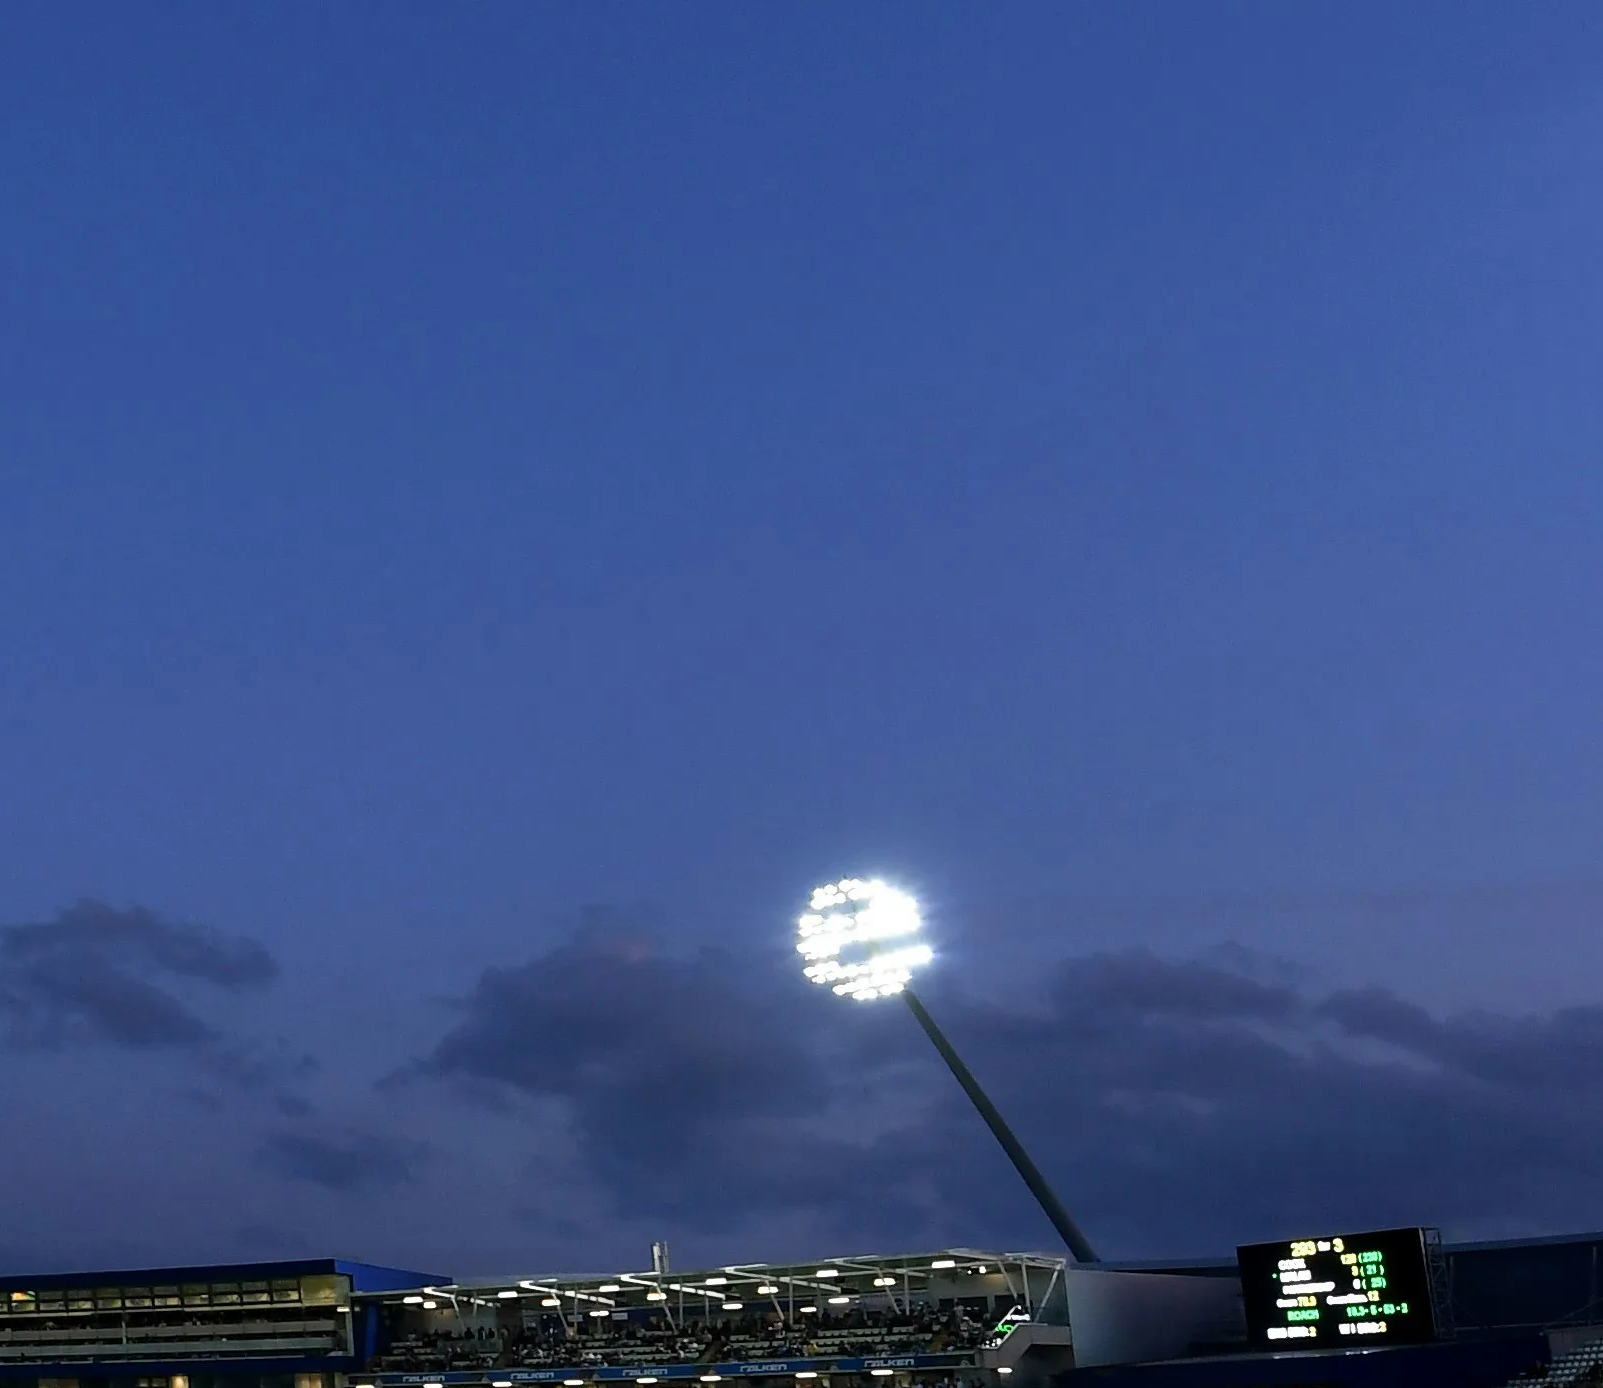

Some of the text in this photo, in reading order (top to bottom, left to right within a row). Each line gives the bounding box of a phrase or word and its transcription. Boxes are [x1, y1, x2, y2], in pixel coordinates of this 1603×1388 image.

[1333, 1238, 1344, 1252] 3
[741, 1364, 787, 1372] FALKEN
[510, 1372, 555, 1380] FALKEN
